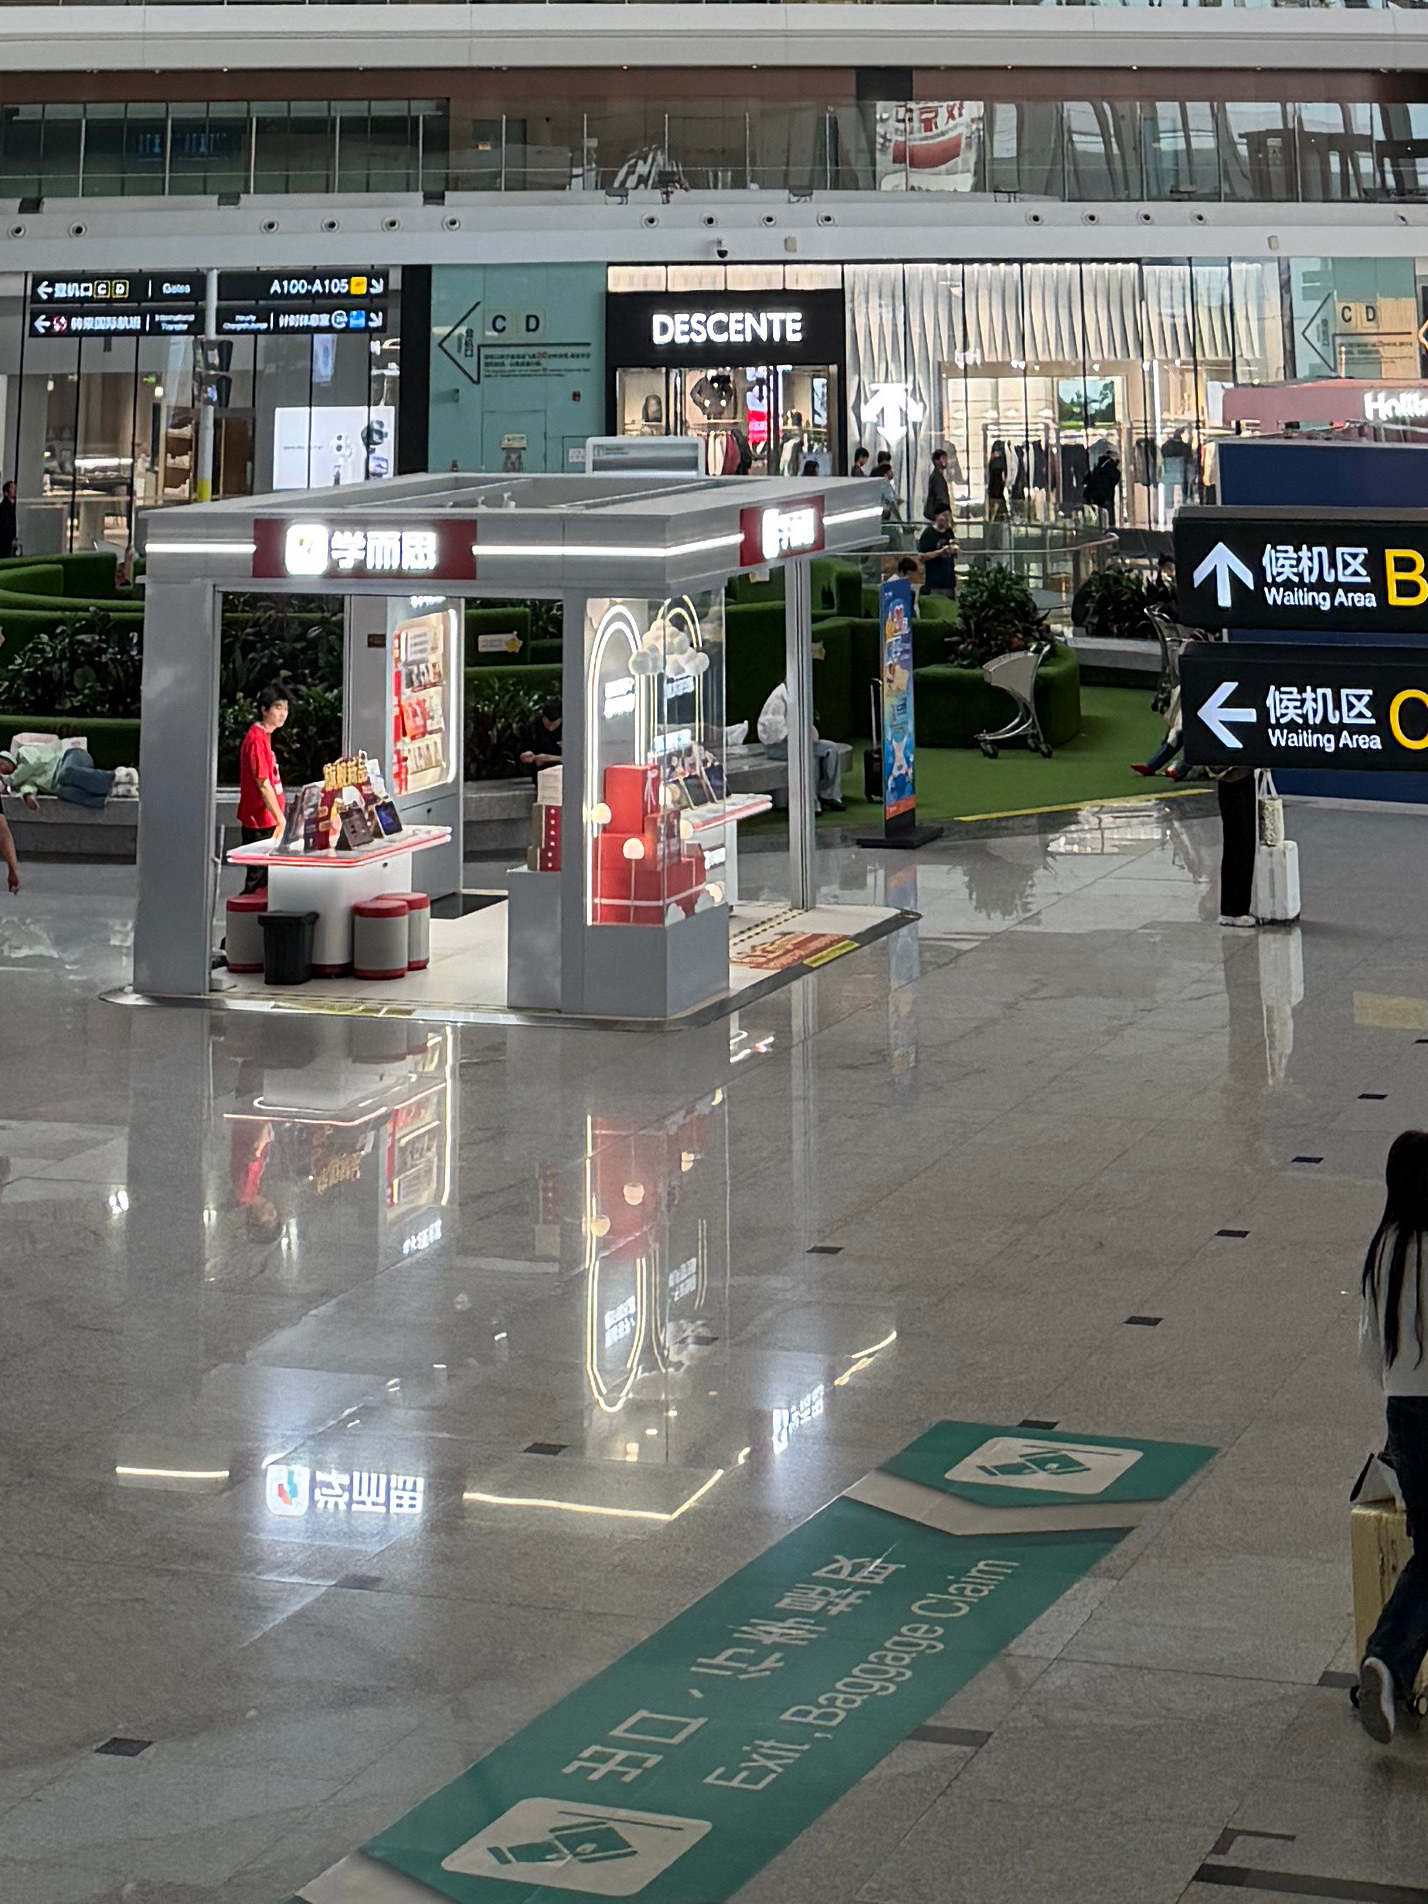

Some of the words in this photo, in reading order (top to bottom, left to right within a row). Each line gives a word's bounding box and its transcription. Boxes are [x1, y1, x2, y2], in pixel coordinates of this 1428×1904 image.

[492, 314, 507, 333] C
[525, 314, 540, 333] D
[652, 312, 803, 345] DESCENTE
[1341, 305, 1353, 323] C
[1365, 305, 1377, 322] D
[331, 531, 437, 570] 学而思
[1262, 543, 1371, 584] 候机区
[1384, 548, 1428, 606] B
[1264, 588, 1330, 611] Waiting
[1334, 590, 1376, 608] Area
[1266, 685, 1376, 725] 候机区
[1268, 729, 1335, 751] Waiting
[1339, 731, 1382, 749] Area
[779, 1623, 944, 1727] Baggage
[910, 1558, 1020, 1618] Claim
[562, 1554, 906, 1783] 出口、行李提取
